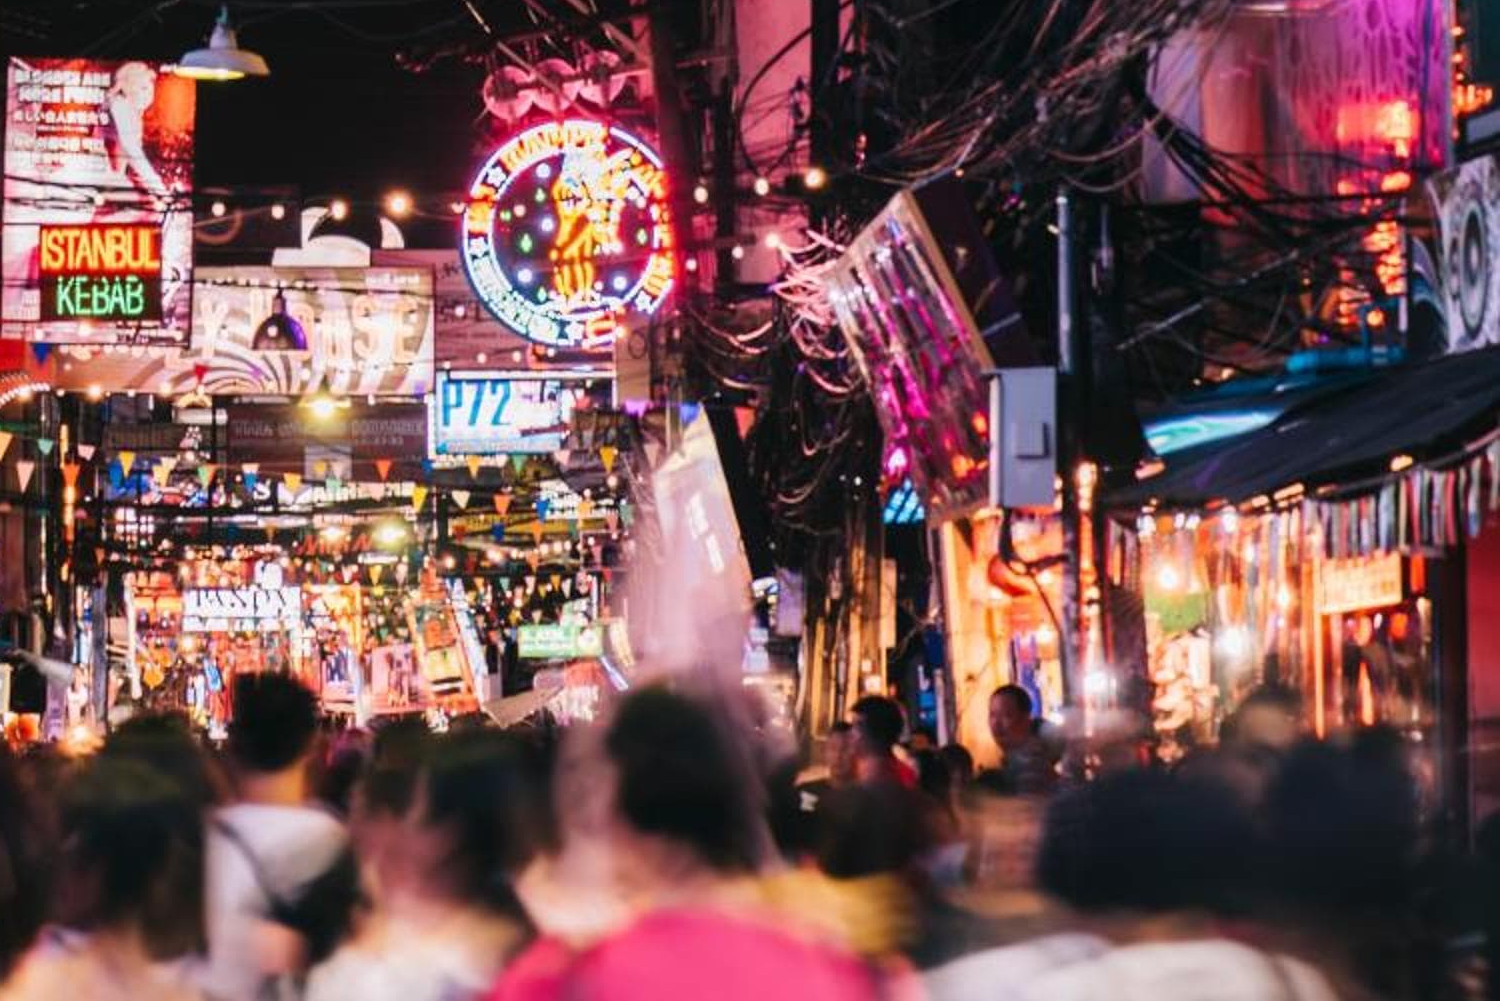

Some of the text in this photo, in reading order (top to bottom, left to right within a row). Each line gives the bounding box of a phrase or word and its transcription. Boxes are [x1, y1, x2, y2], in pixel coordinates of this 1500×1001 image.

[40, 228, 161, 271] ISTANBUL
[56, 275, 145, 317] KEBAB
[441, 380, 513, 427] P72
